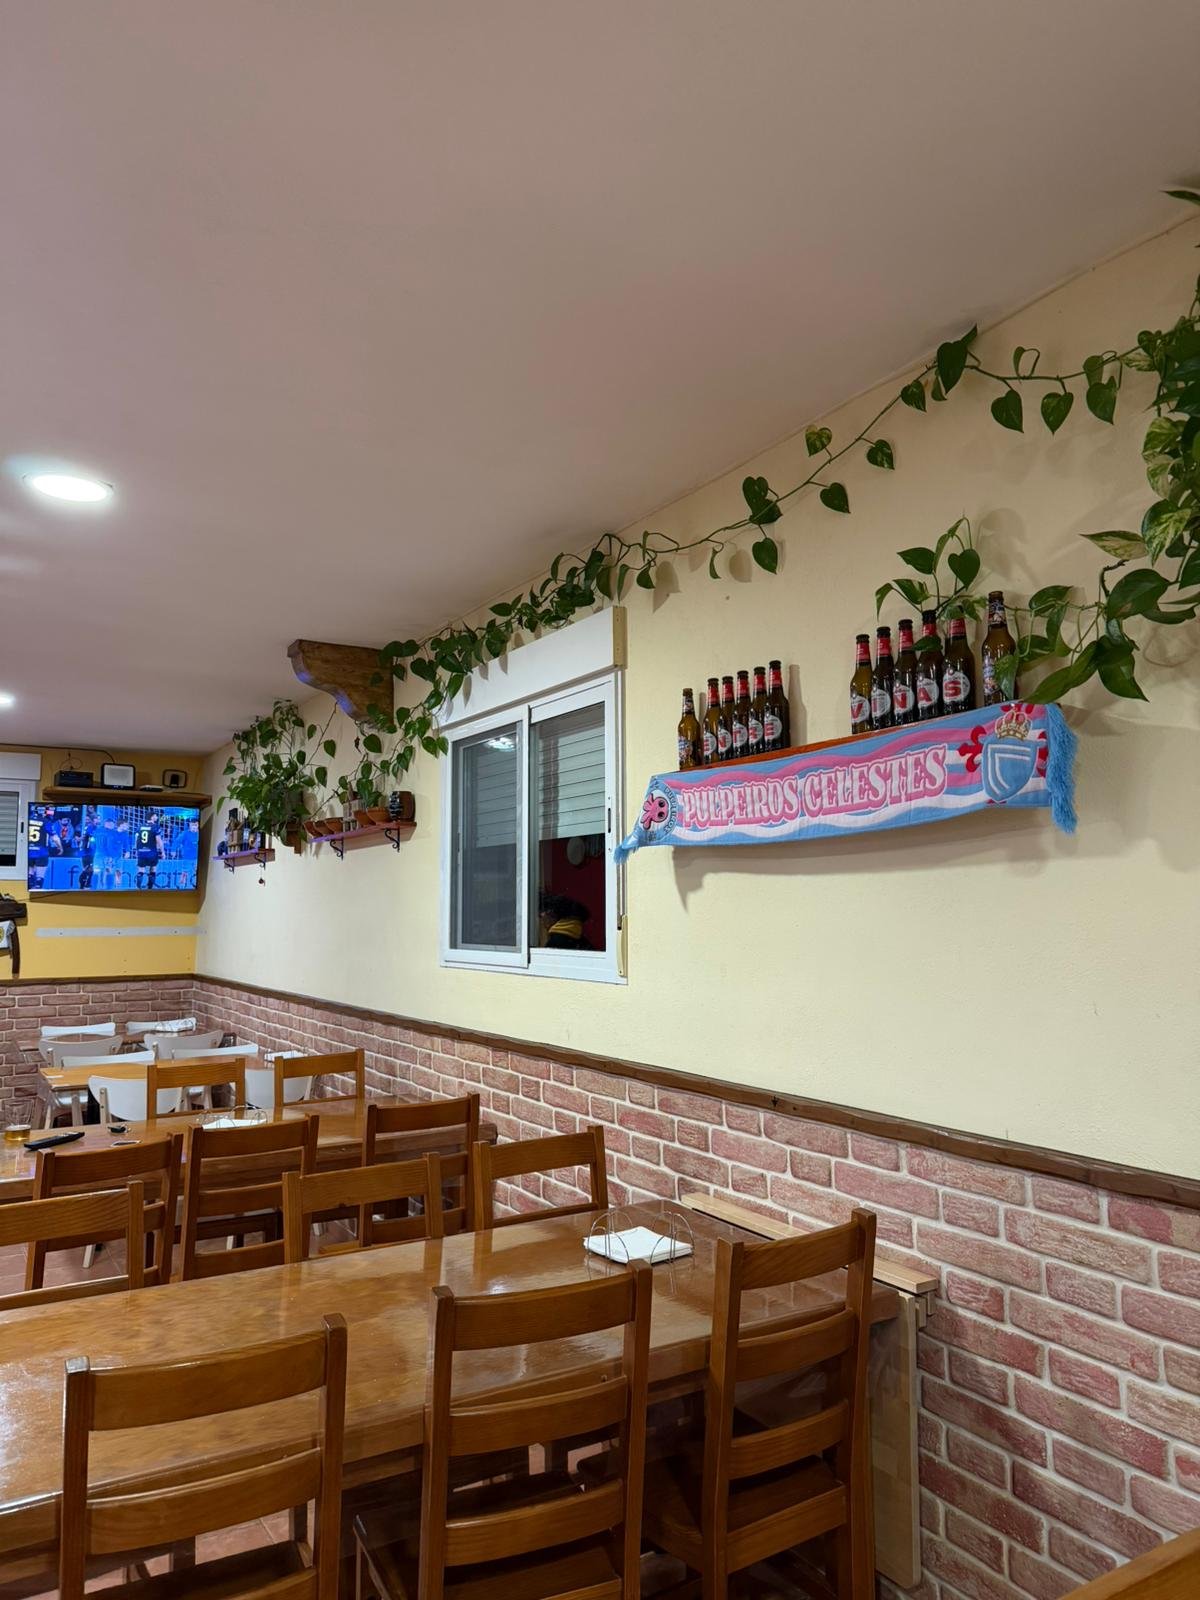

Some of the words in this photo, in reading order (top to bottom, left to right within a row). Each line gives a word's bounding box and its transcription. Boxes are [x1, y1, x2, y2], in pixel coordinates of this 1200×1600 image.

[682, 777, 799, 827] PULPEIROS
[802, 745, 947, 817] CELESTES
[141, 831, 149, 844] 9
